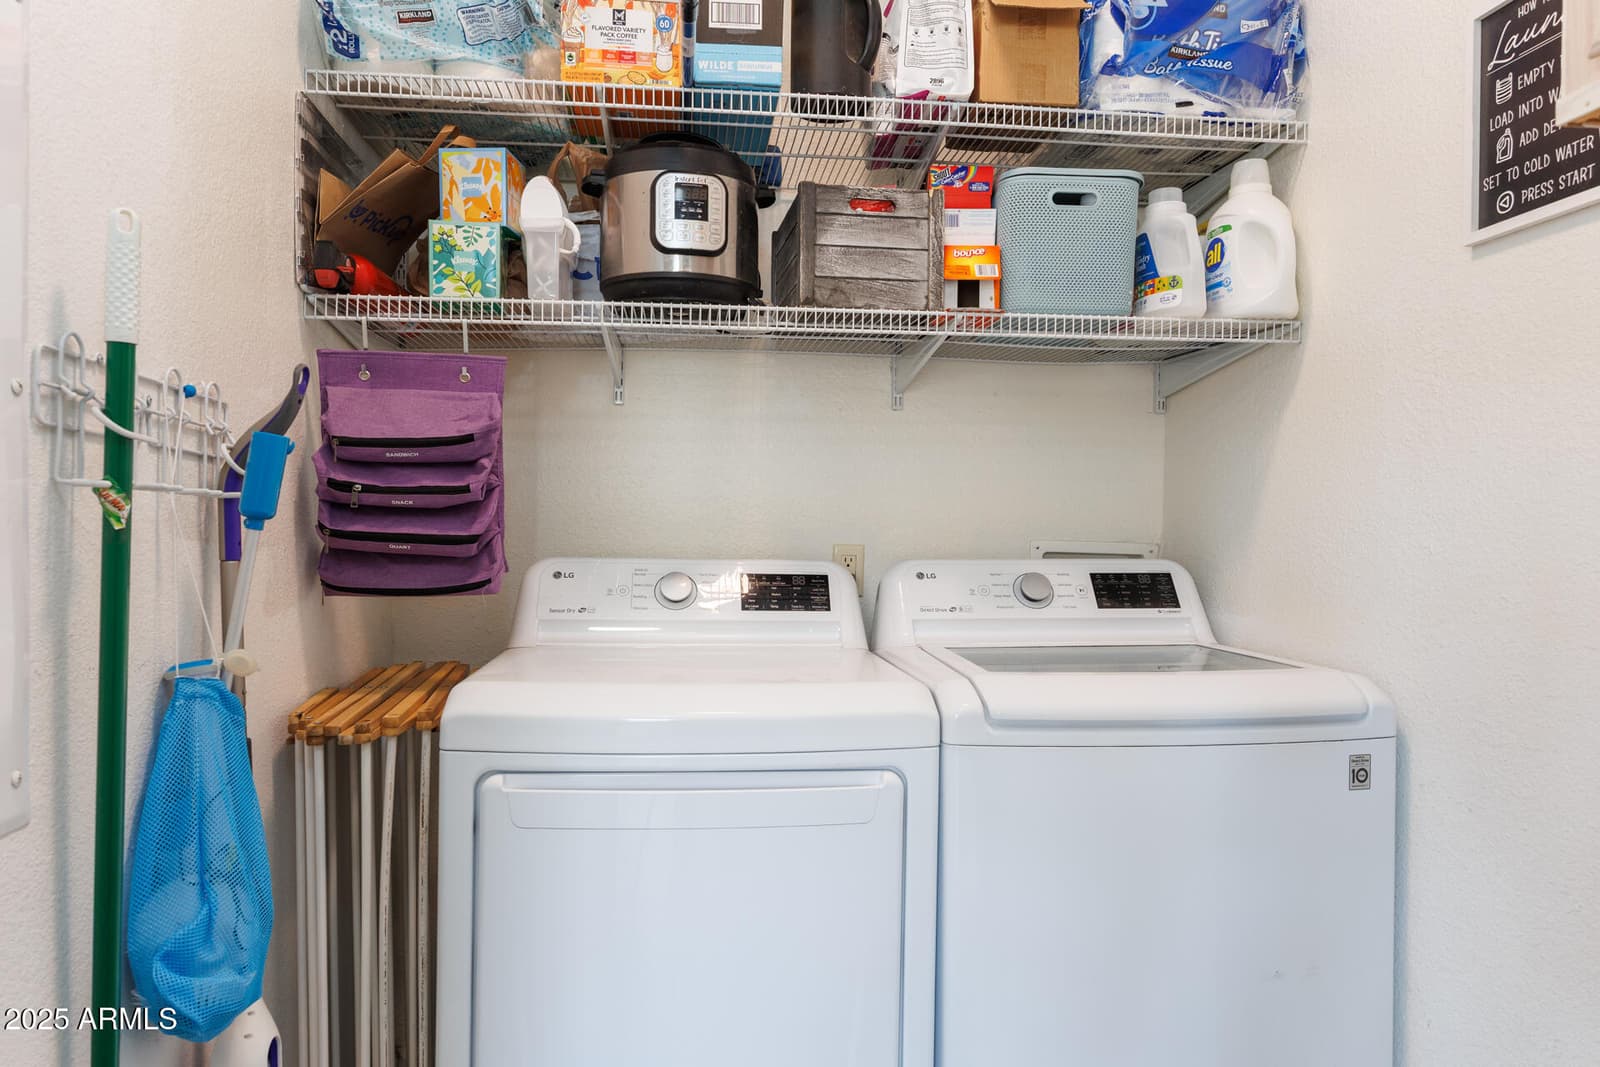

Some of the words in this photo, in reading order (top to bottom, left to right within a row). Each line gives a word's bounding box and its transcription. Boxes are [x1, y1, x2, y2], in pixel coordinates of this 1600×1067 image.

[1517, 1, 1537, 19] HOW
[591, 24, 622, 32] FLAVORED
[623, 26, 647, 34] VARIETY
[659, 19, 671, 28] 60
[1487, 11, 1563, 71] Laun
[697, 60, 735, 71] WILDE
[1517, 58, 1555, 91] EMPTY
[1489, 110, 1515, 132] LOAD
[1518, 95, 1544, 120] INTO
[1519, 129, 1539, 148] ADD
[1482, 171, 1502, 192] SET
[1506, 166, 1521, 183] TO
[1523, 153, 1551, 176] COLD
[1554, 134, 1595, 163] WATER
[1521, 179, 1555, 204] PRESS
[1557, 162, 1596, 191] START
[953, 247, 985, 258] bounce
[1206, 241, 1222, 268] all
